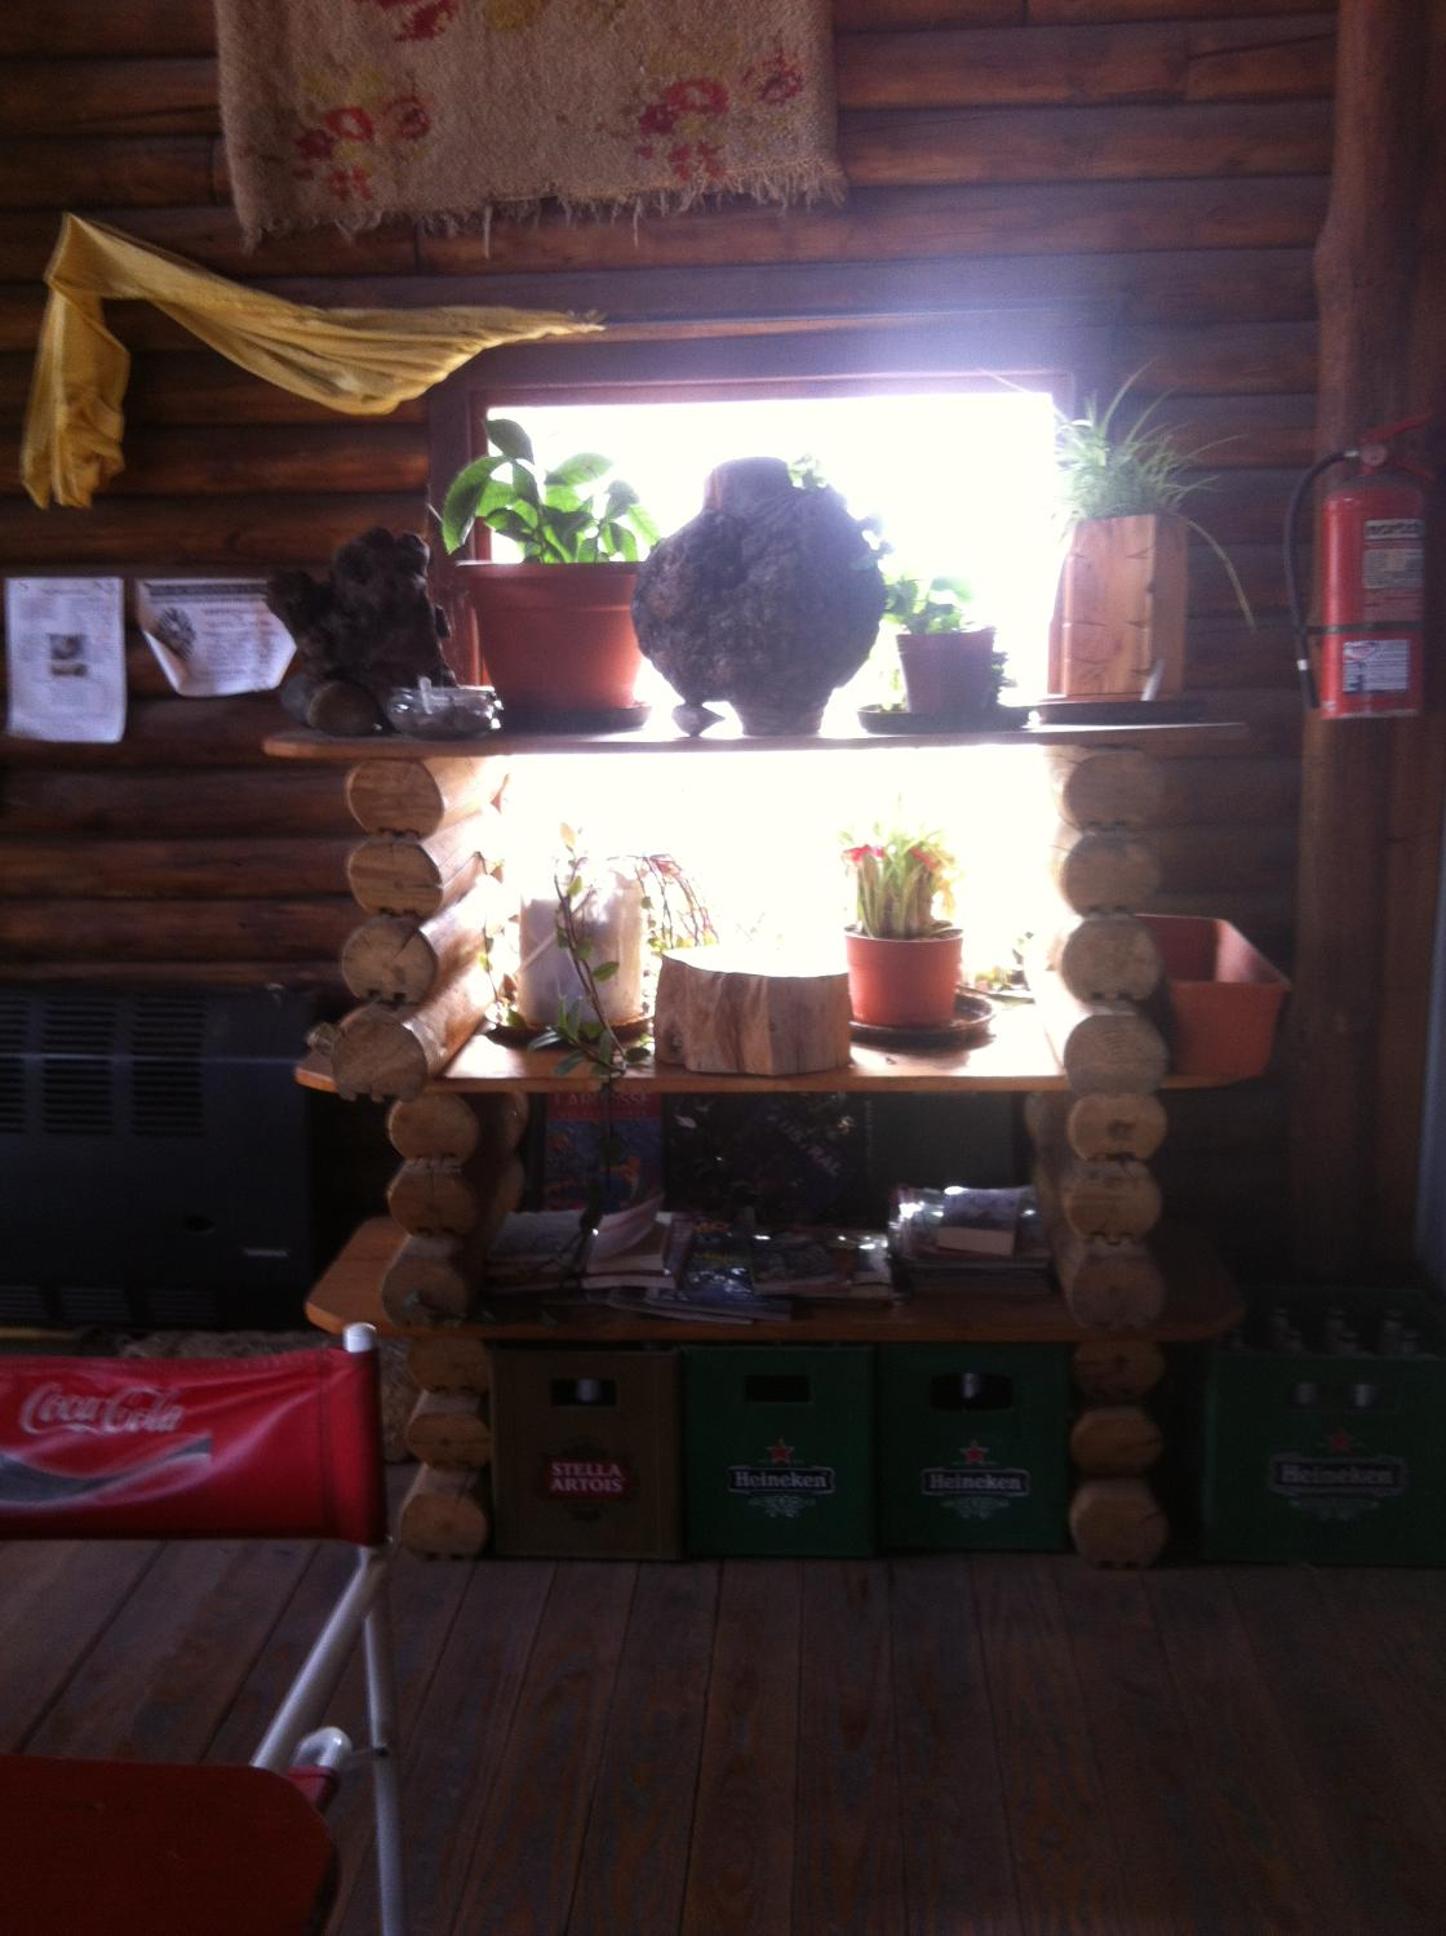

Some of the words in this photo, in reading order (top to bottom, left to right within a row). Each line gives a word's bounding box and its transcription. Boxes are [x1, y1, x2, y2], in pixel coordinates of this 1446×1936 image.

[551, 1461, 624, 1478] STELLA
[550, 1477, 624, 1492] ARTOIS
[735, 1471, 828, 1489] Heineken
[930, 1474, 1021, 1490] Heineken
